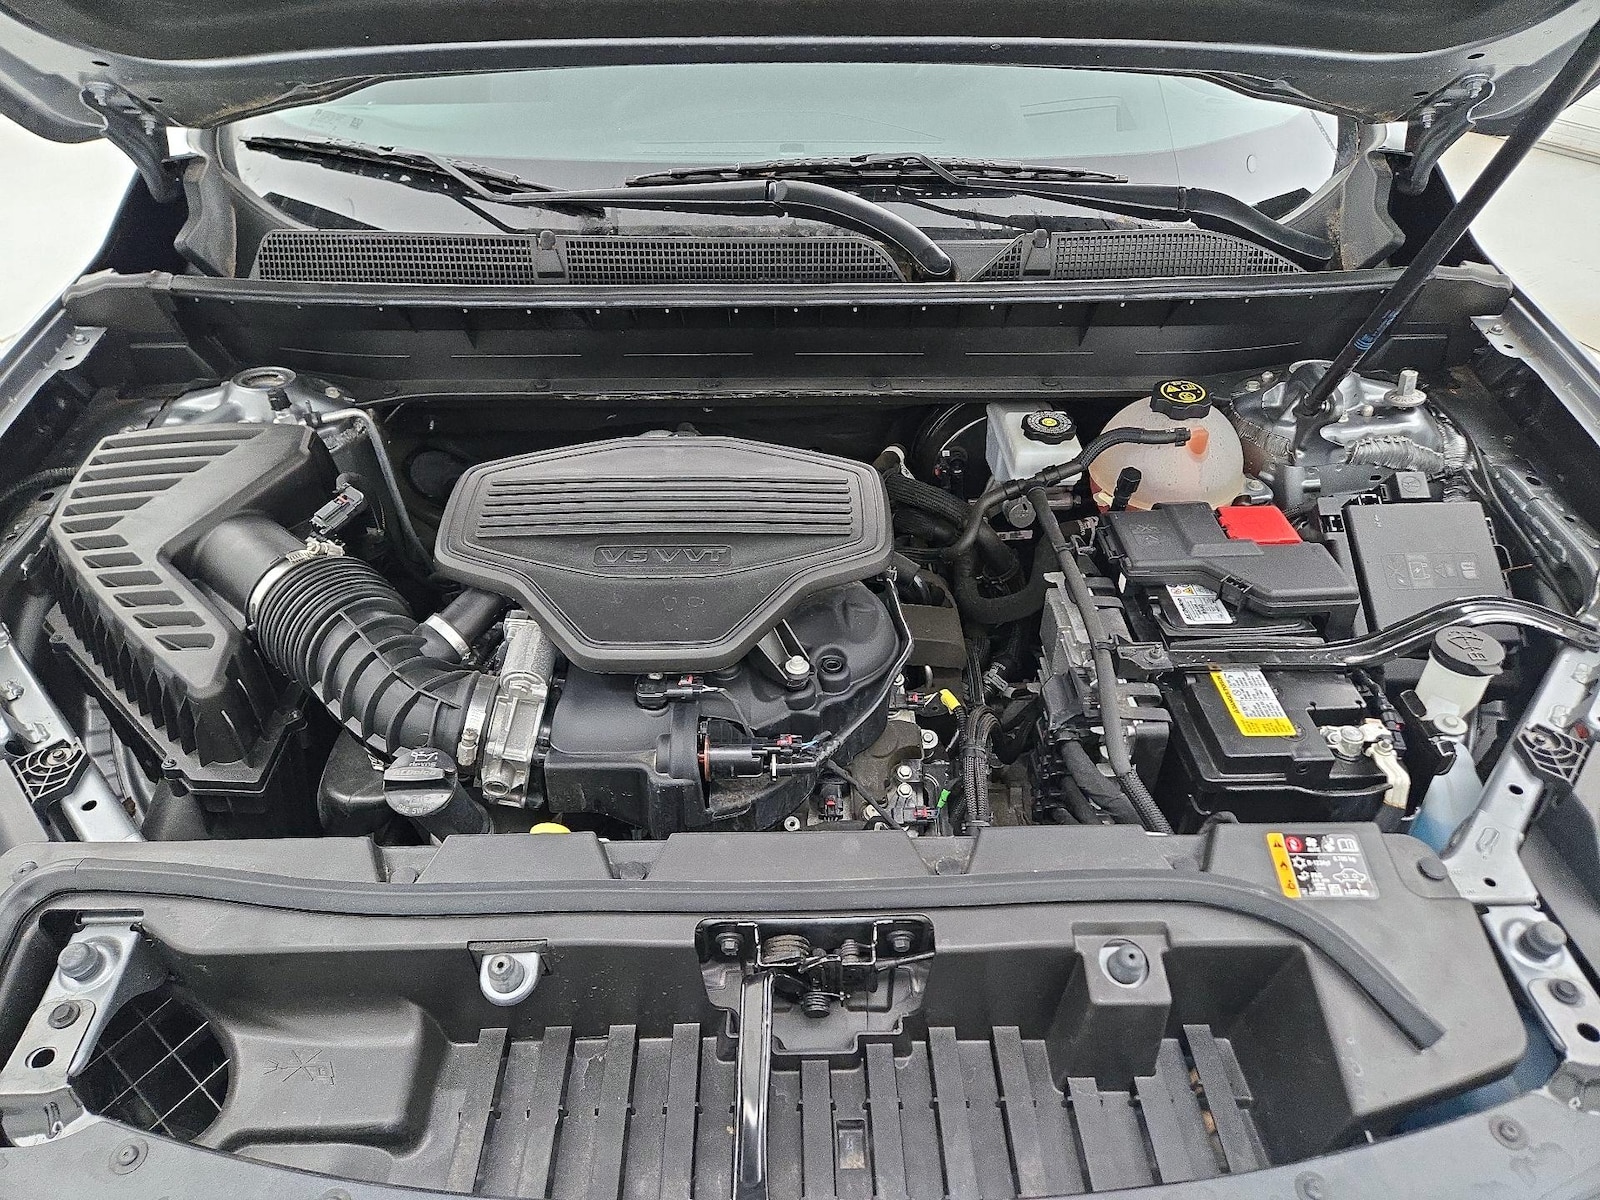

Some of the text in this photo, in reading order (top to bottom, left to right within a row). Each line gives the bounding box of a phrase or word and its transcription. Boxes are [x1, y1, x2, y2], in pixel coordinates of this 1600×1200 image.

[600, 548, 727, 562] V6 VVT
[397, 803, 410, 813] SAE
